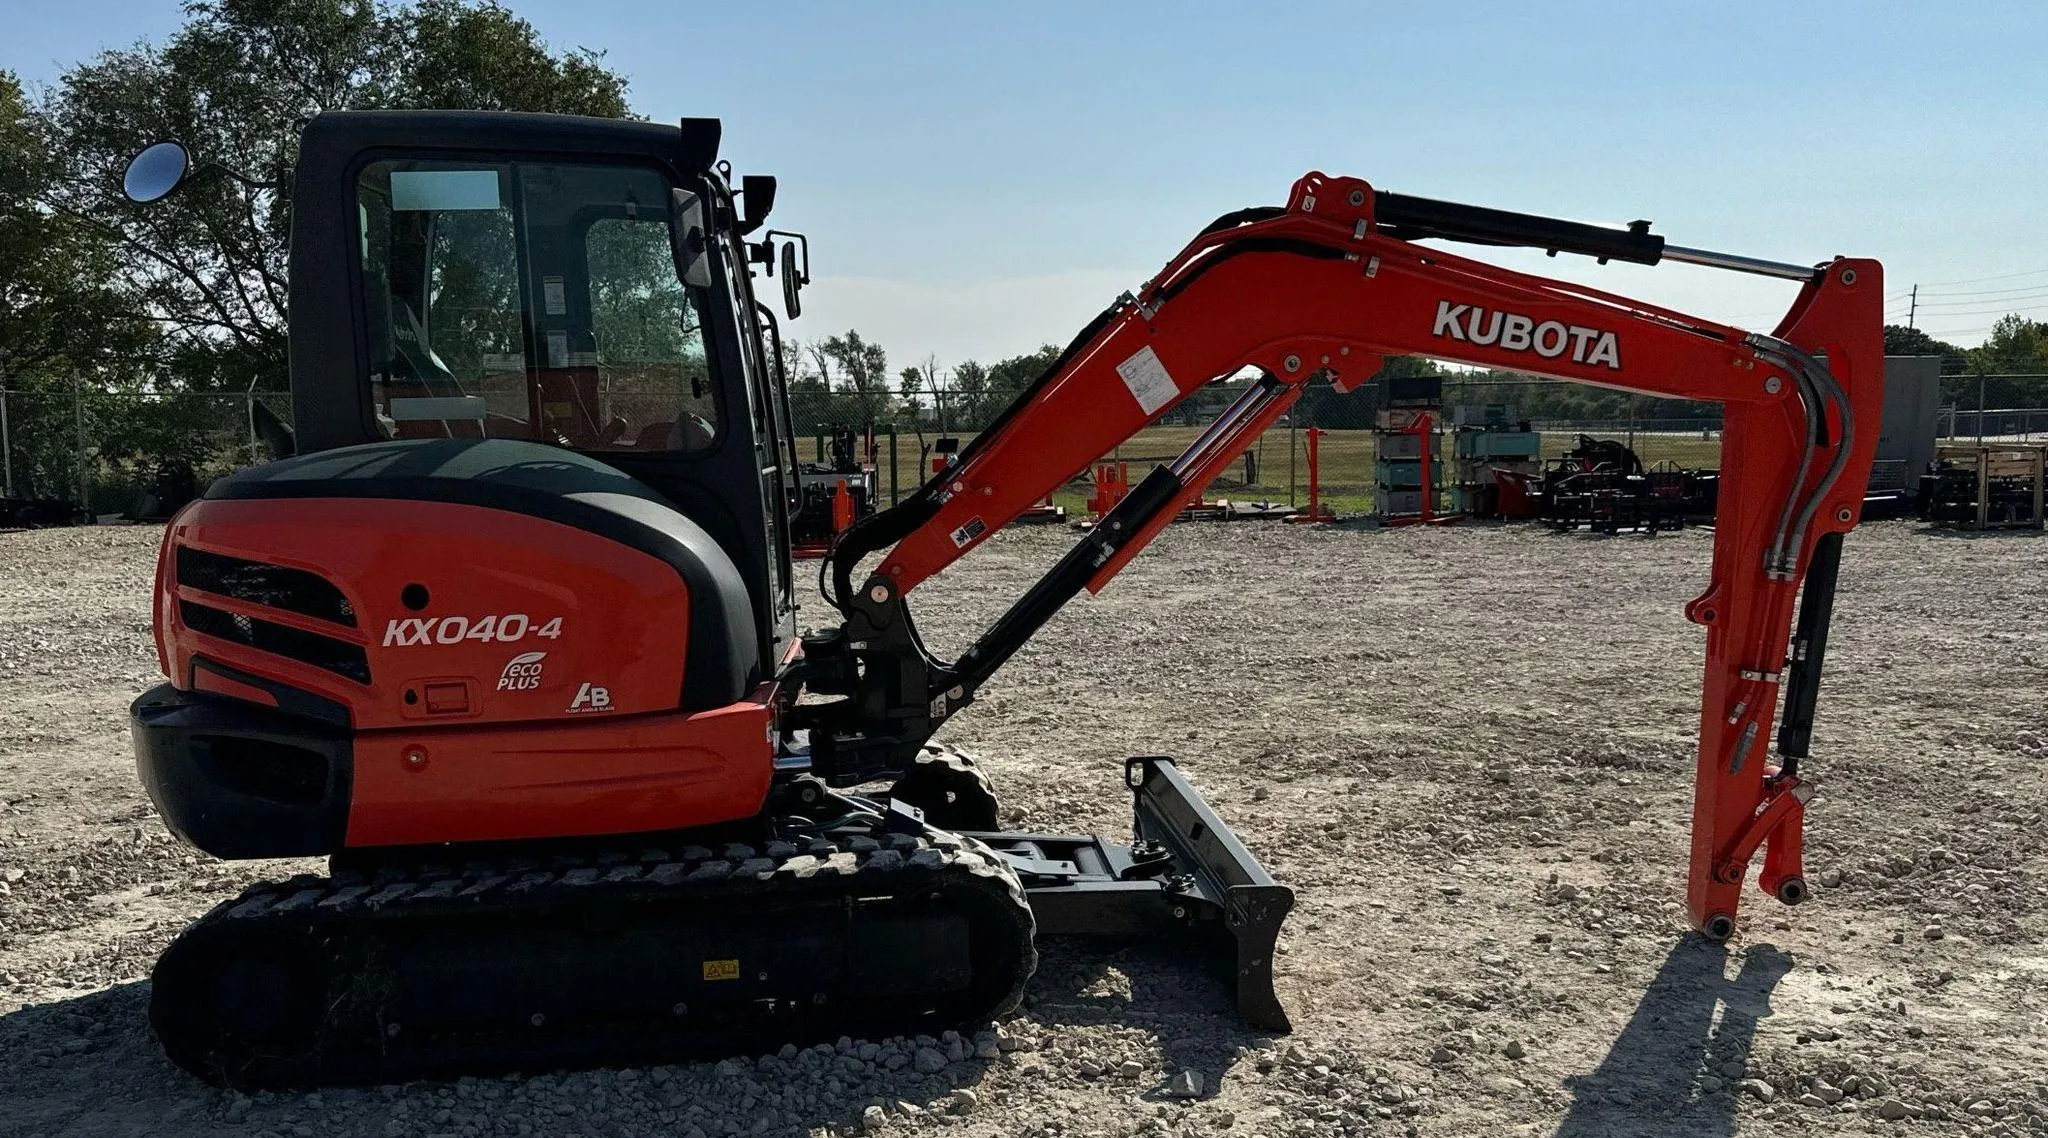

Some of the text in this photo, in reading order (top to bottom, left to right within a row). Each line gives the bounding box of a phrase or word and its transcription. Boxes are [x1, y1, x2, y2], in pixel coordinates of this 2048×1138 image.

[1432, 300, 1620, 369] KUBOTA
[382, 614, 563, 647] KX040-4
[509, 663, 543, 676] eco
[497, 676, 541, 691] PLUS
[570, 682, 610, 708] AB
